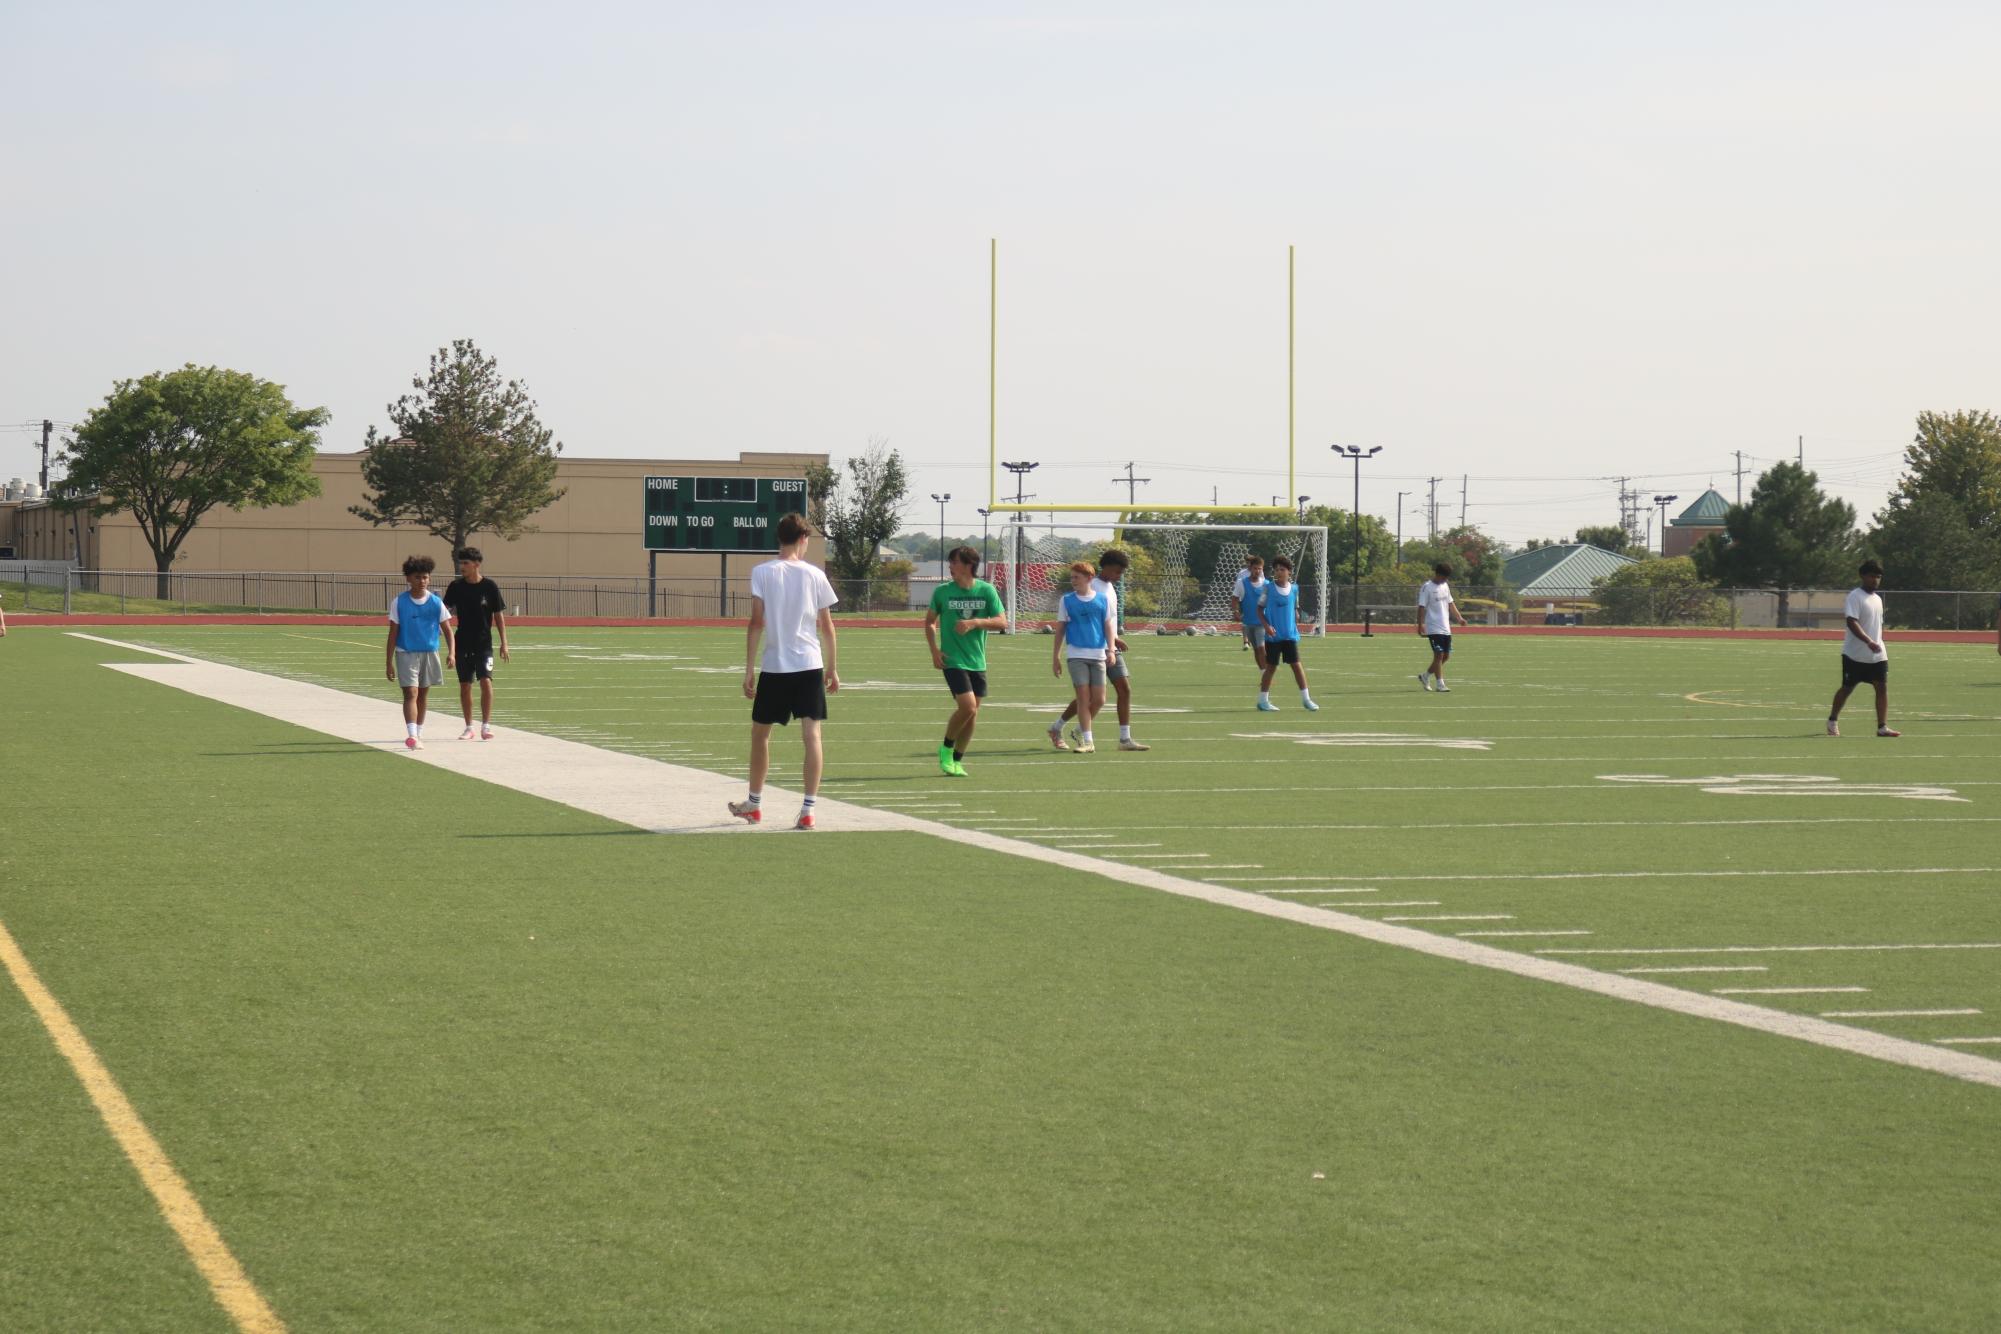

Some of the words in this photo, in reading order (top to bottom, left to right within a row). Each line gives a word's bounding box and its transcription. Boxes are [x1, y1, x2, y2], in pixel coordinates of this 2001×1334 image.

[648, 479, 678, 490] HOME
[772, 480, 804, 492] GUEST
[649, 515, 678, 526] DOWN
[686, 516, 698, 527] TO
[701, 516, 714, 527] GO
[733, 517, 754, 528] BALL
[756, 517, 768, 528] ON
